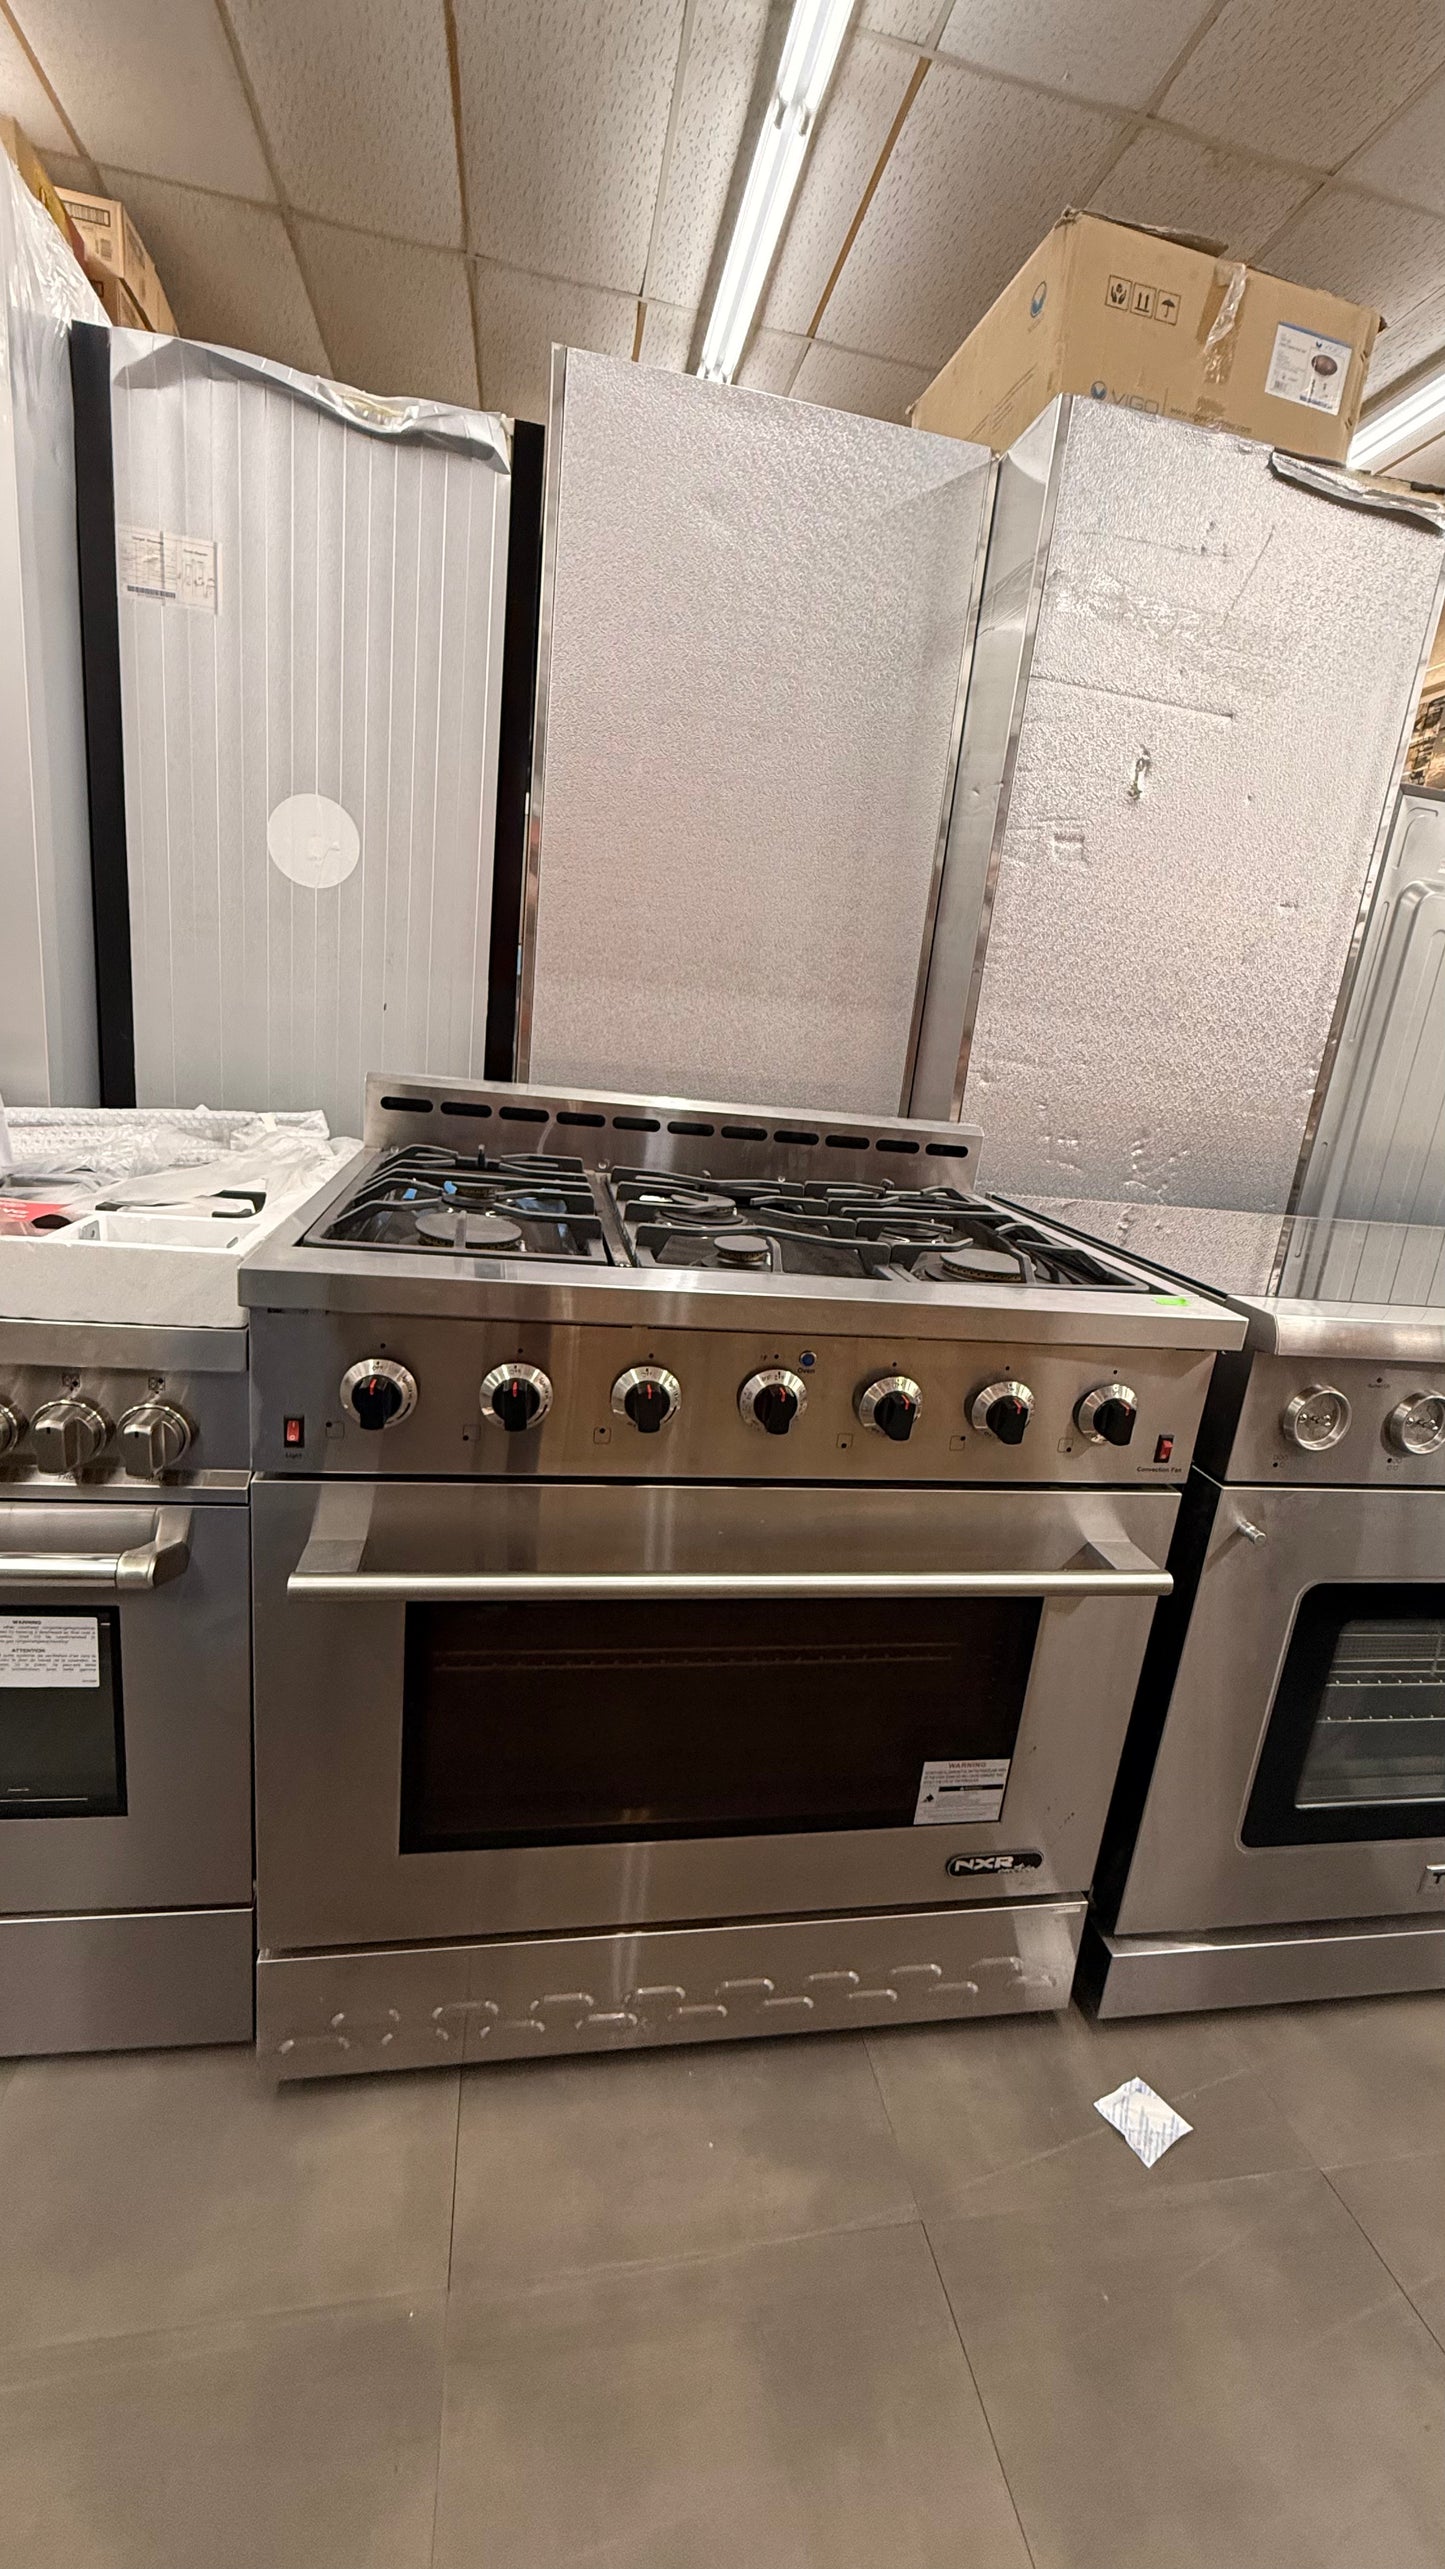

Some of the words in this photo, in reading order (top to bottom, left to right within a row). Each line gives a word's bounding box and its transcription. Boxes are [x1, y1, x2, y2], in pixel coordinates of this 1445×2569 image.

[1111, 389, 1160, 416] VIGO
[1136, 1466, 1170, 1474] Convection
[1171, 1466, 1182, 1474] Fan
[954, 1855, 1015, 1872] NXR
